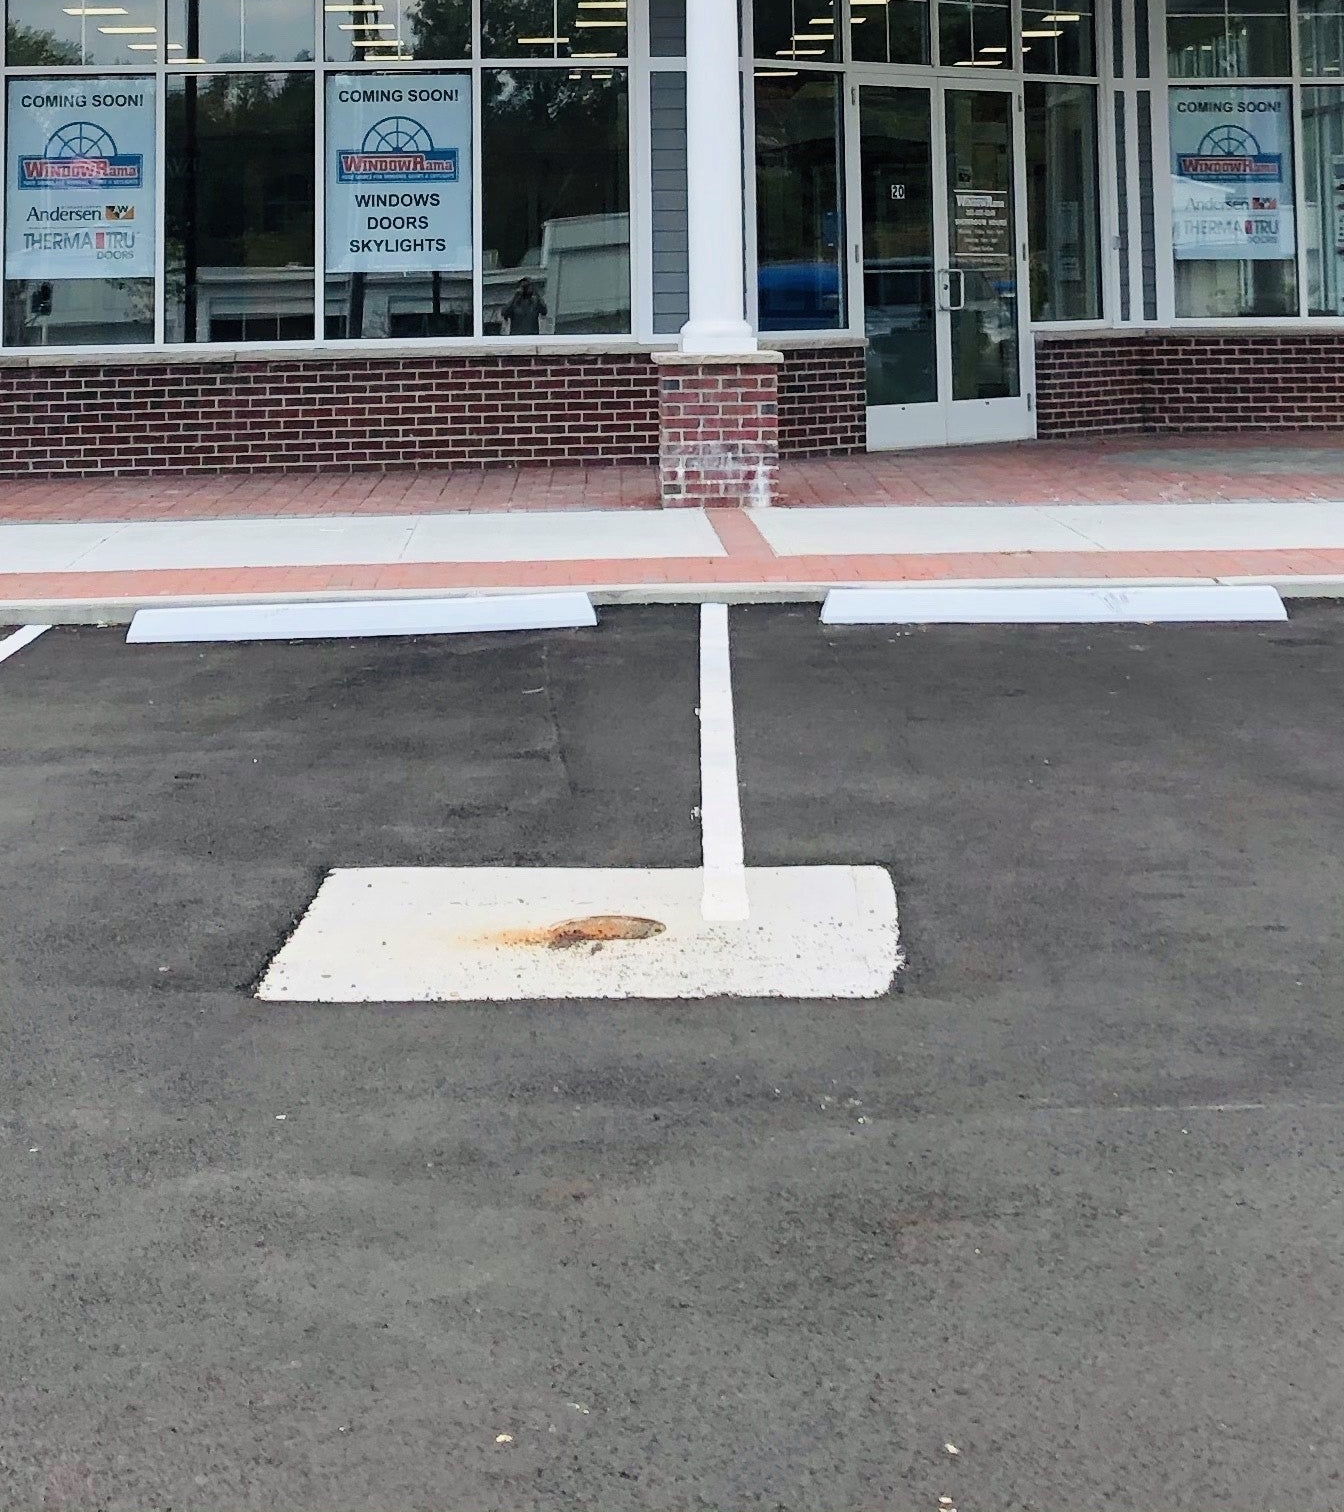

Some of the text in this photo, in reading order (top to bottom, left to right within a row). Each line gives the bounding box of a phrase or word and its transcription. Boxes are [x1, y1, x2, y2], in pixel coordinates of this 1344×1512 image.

[21, 94, 144, 108] COMING SOON!
[339, 89, 459, 102] COMING SOON!
[1177, 101, 1282, 113] COMING SOON!
[892, 186, 904, 198] 20
[355, 193, 441, 208] WINDOWS
[26, 206, 102, 222] Andersen
[367, 216, 429, 230] DOORS
[23, 231, 136, 250] THERMA TRU
[349, 238, 447, 253] SKYLIGHTS
[97, 250, 134, 260] DOORS
